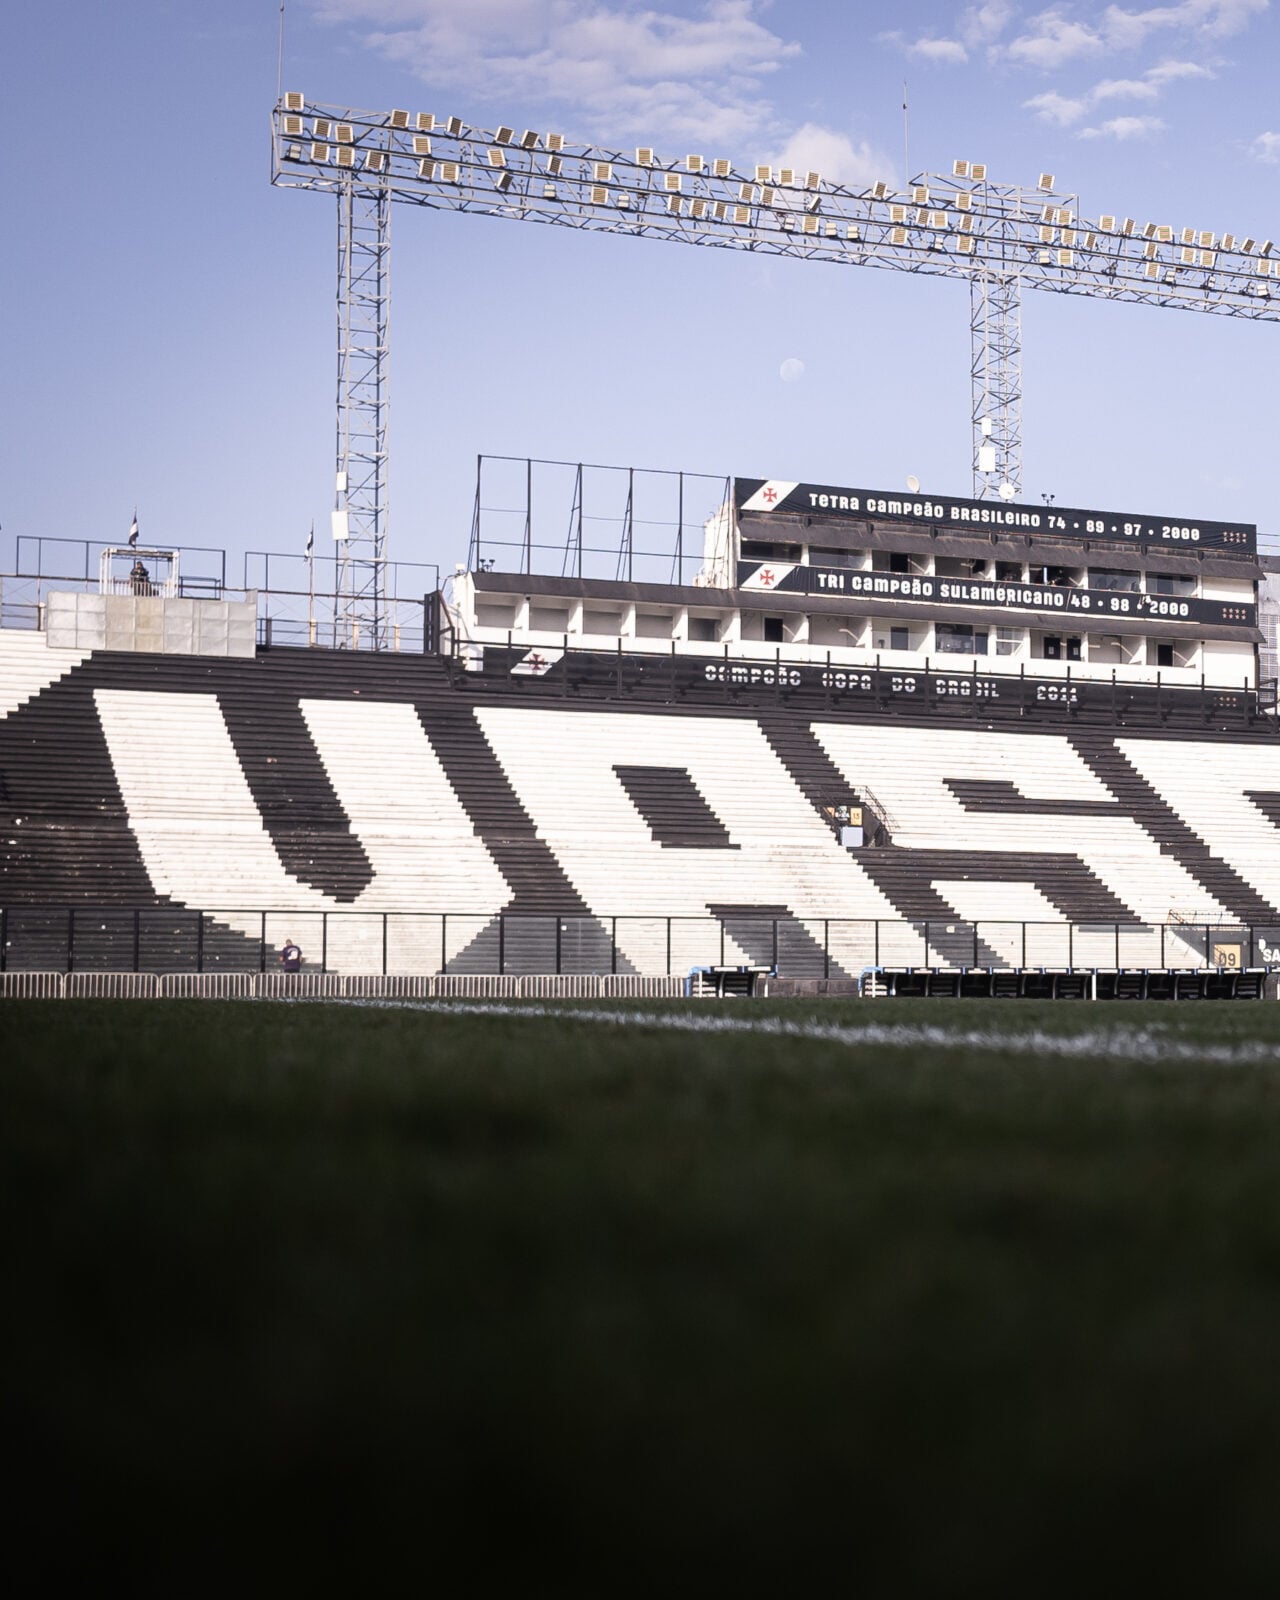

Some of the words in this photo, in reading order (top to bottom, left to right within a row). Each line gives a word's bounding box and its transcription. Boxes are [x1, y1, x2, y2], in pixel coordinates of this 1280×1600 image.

[1047, 515, 1067, 530] 74
[1086, 520, 1105, 534] 89
[1123, 522, 1142, 537] 97
[1162, 525, 1200, 541] 2000
[817, 573, 845, 589] TRI
[1070, 594, 1091, 609] 48
[1110, 597, 1130, 612] 98
[1149, 601, 1190, 617] 2000
